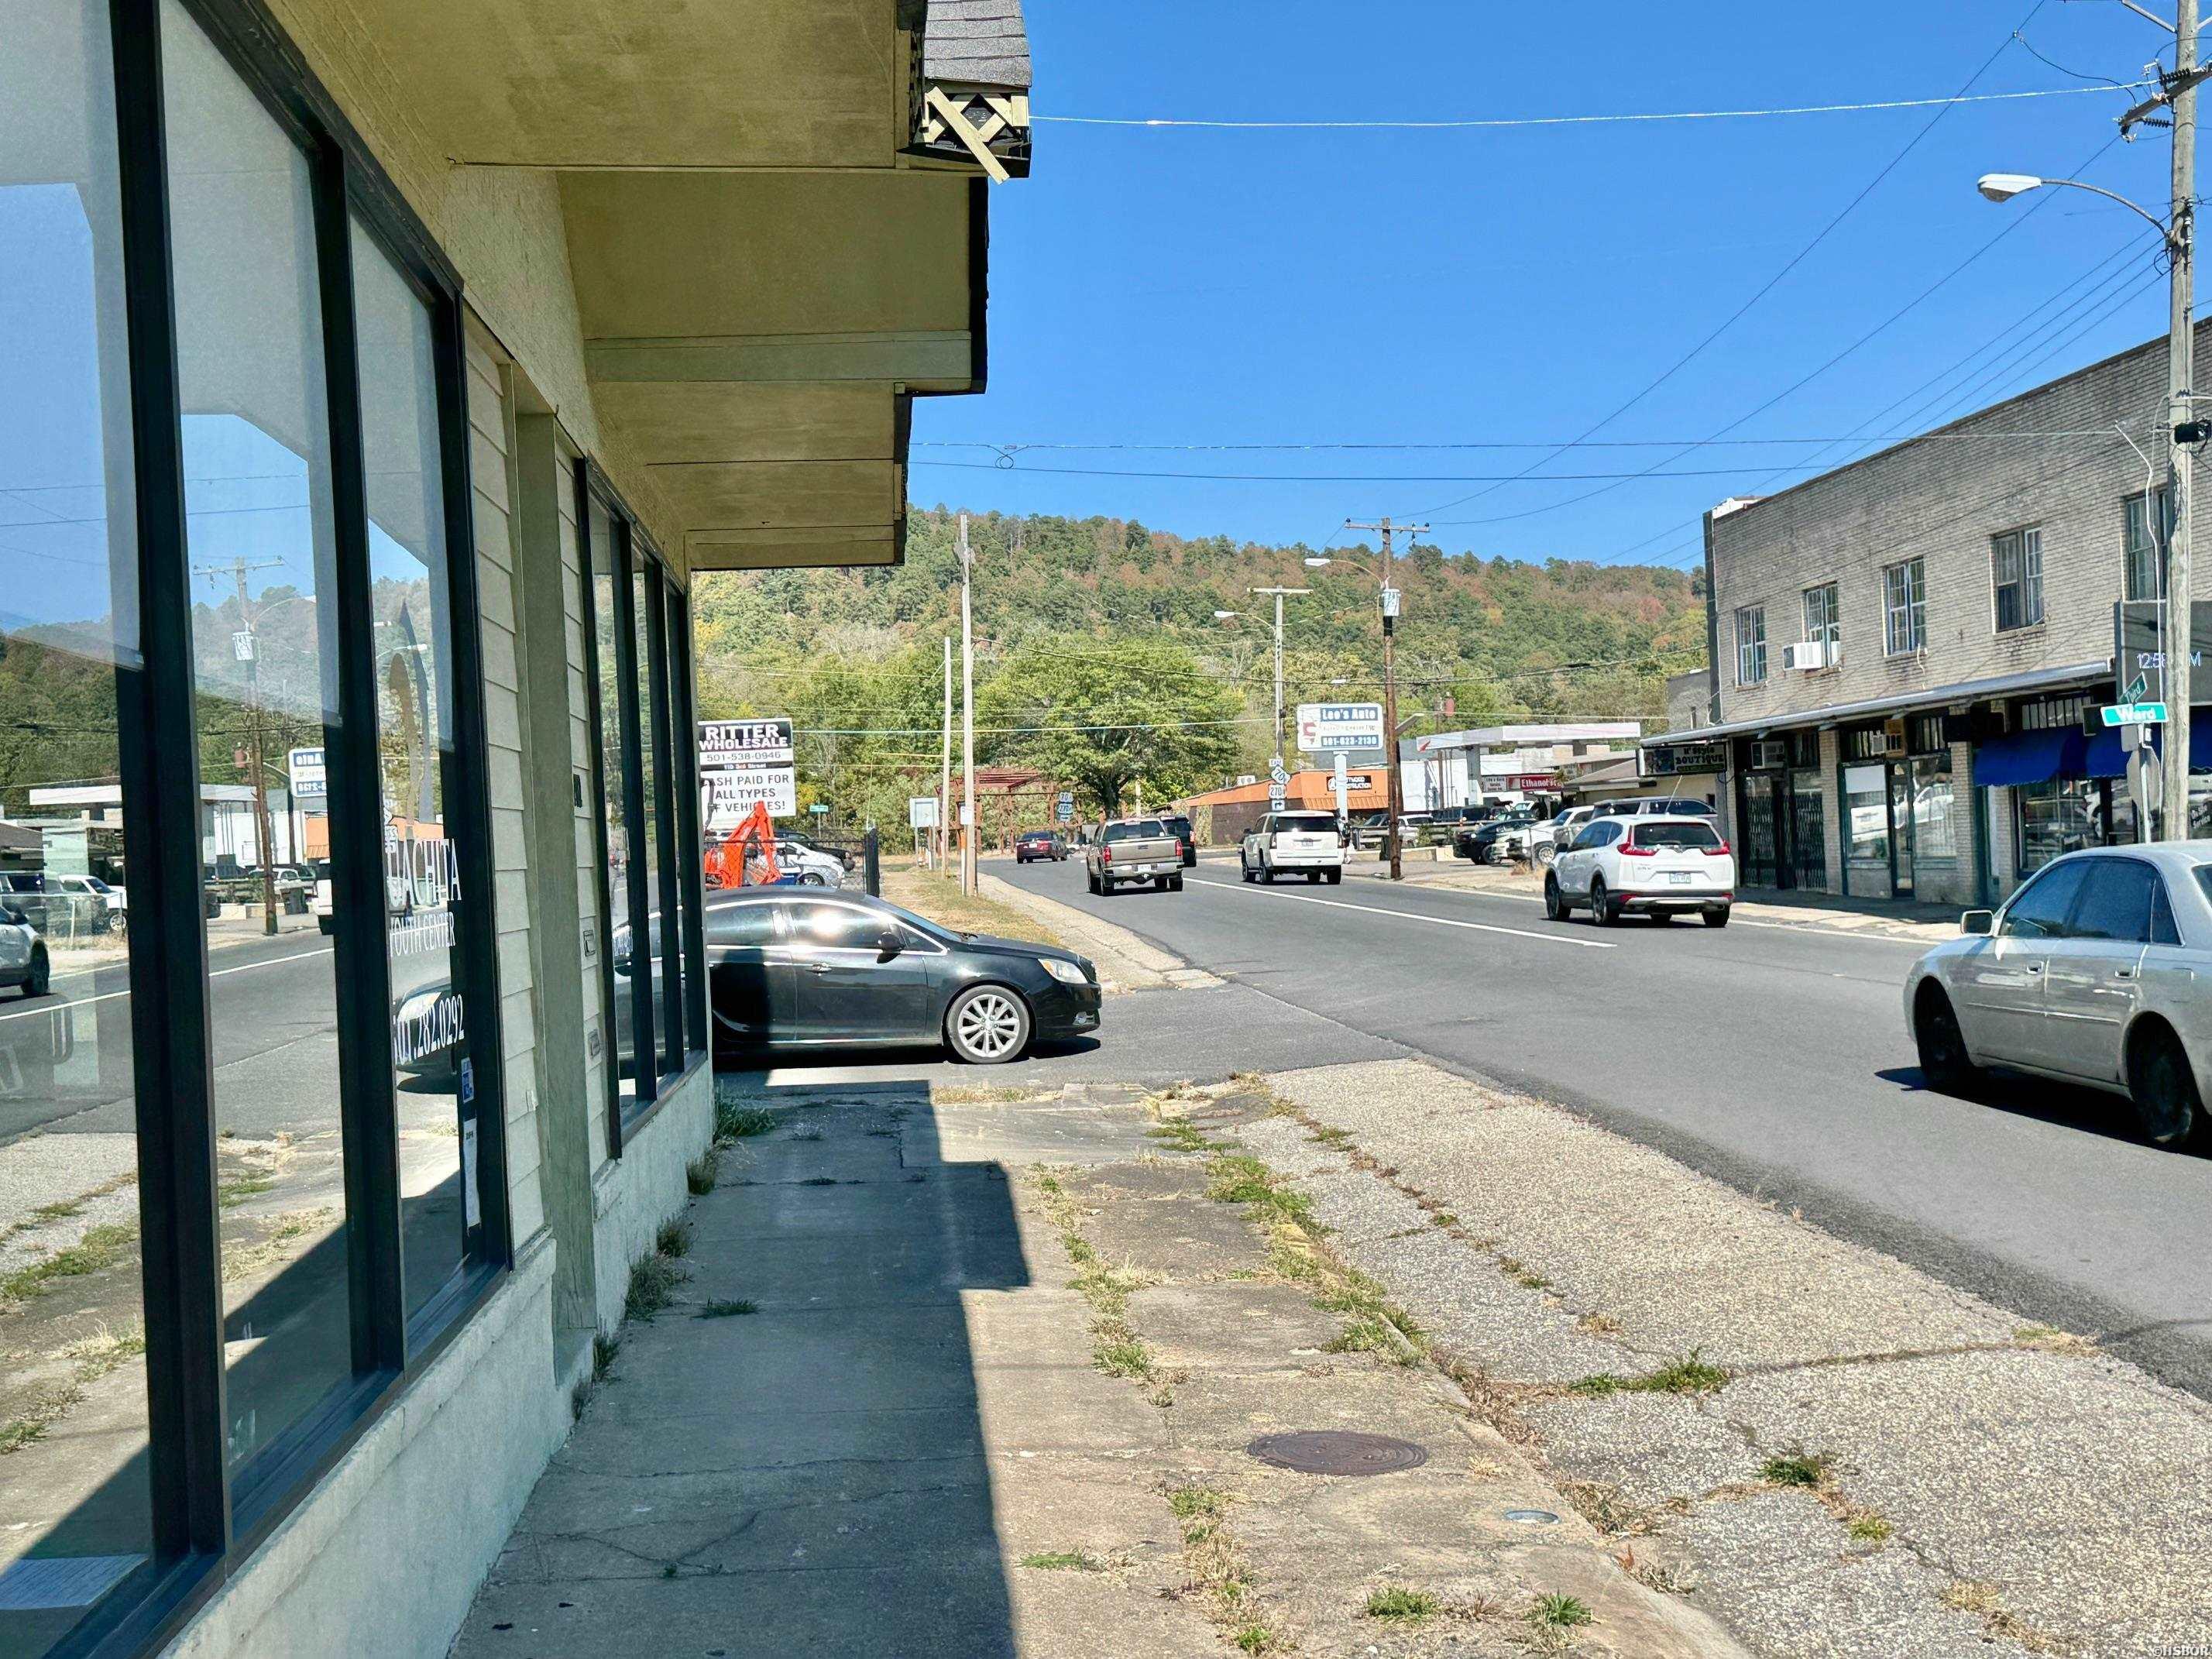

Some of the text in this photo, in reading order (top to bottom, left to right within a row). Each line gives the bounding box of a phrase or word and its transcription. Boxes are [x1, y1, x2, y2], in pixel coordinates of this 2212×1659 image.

[1352, 708, 1376, 720] Auto
[2116, 706, 2156, 721] Ward
[705, 724, 779, 740] RITTER
[699, 737, 788, 750] WHOLESALE
[706, 751, 781, 762] 501-538-0946
[1675, 754, 1723, 764] BOUTIQUE
[737, 775, 763, 785] PAID
[768, 775, 789, 784] FOR
[1521, 778, 1549, 788] Ethanol
[715, 788, 776, 799] ALL TYPES
[725, 801, 785, 812] VEHIES!
[387, 838, 462, 907] UACHITA
[389, 912, 455, 957] YOUTH CENTER
